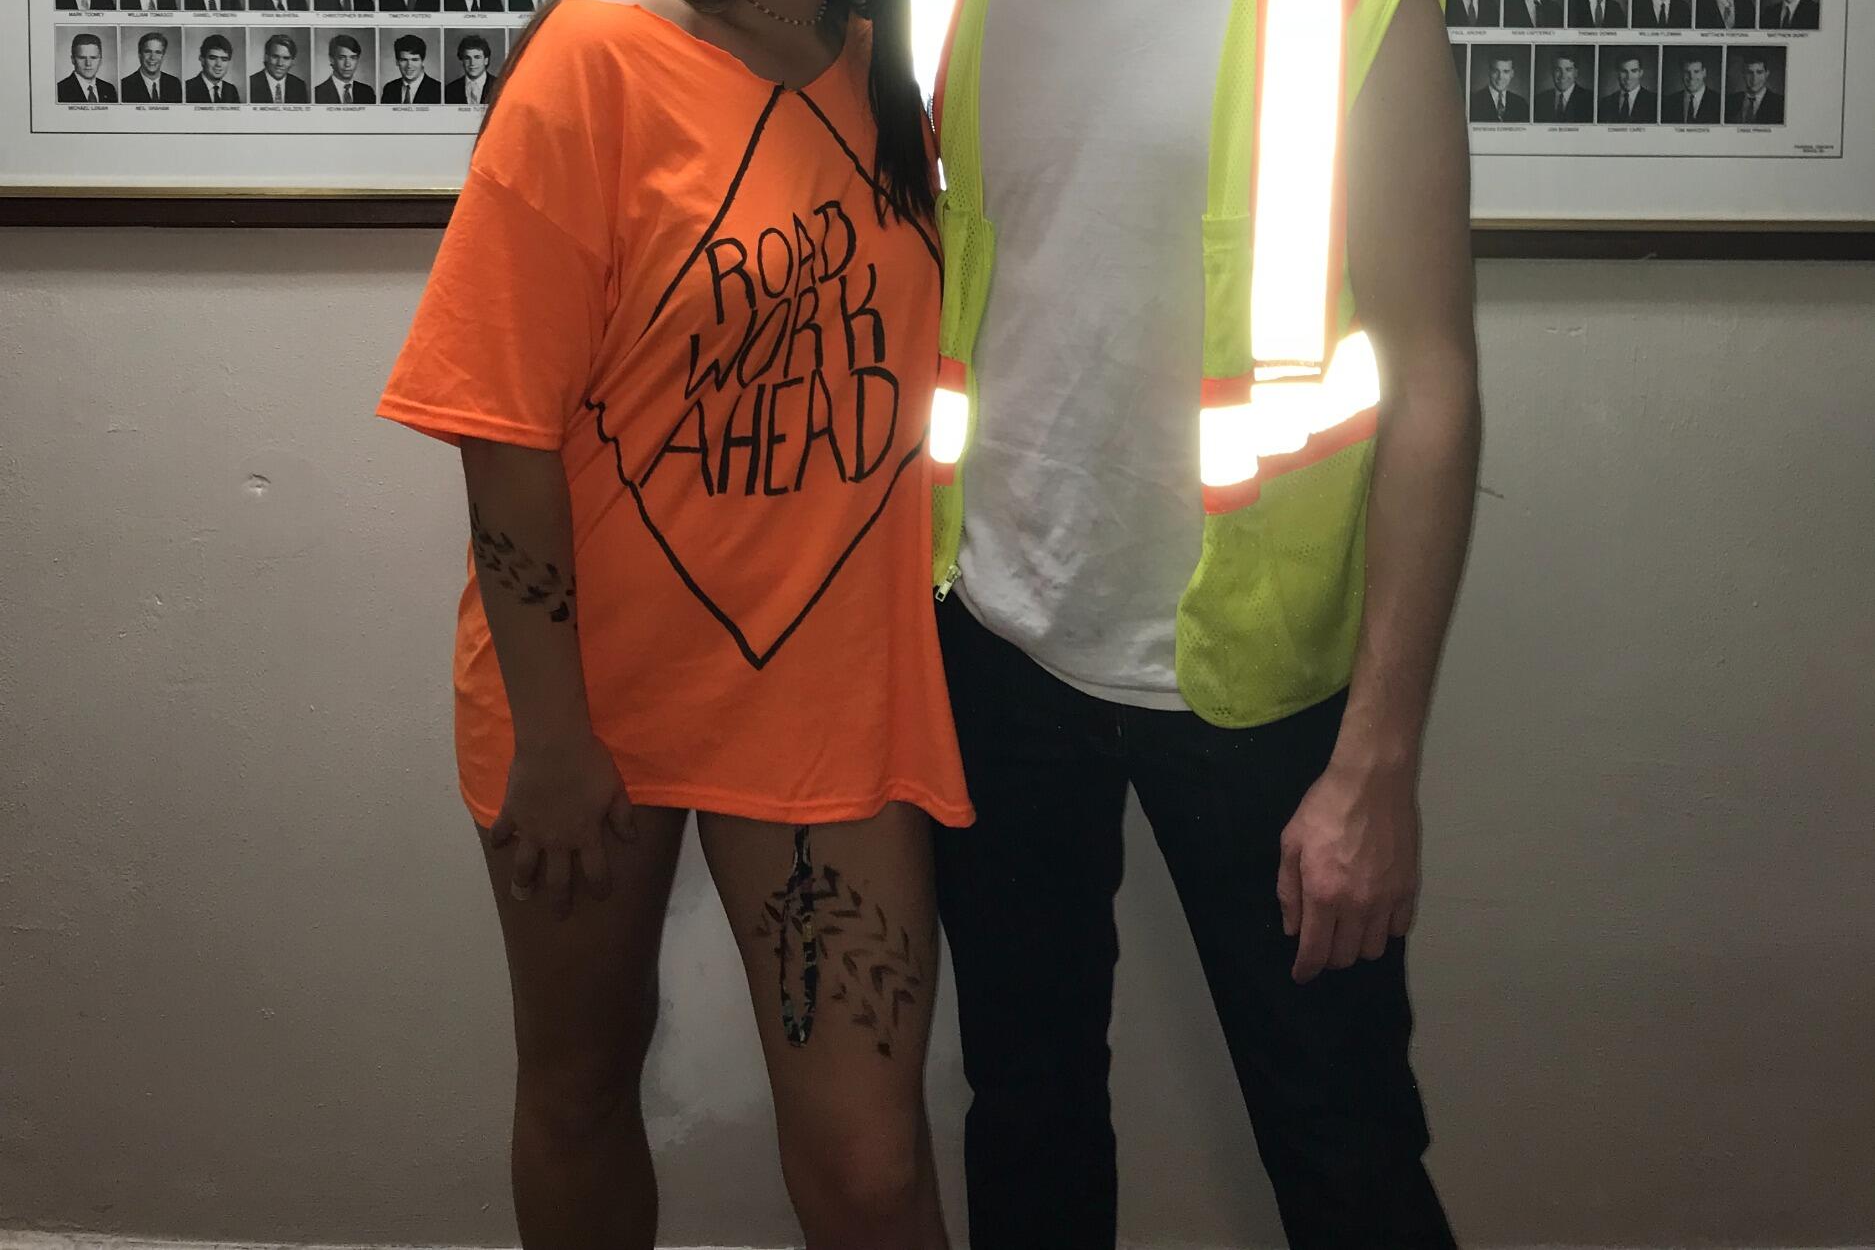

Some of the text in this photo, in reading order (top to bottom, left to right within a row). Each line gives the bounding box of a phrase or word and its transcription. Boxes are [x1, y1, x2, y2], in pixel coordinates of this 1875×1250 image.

[704, 200, 857, 325] ROAD
[684, 263, 886, 400] WORK
[640, 366, 900, 497] AHEAD
